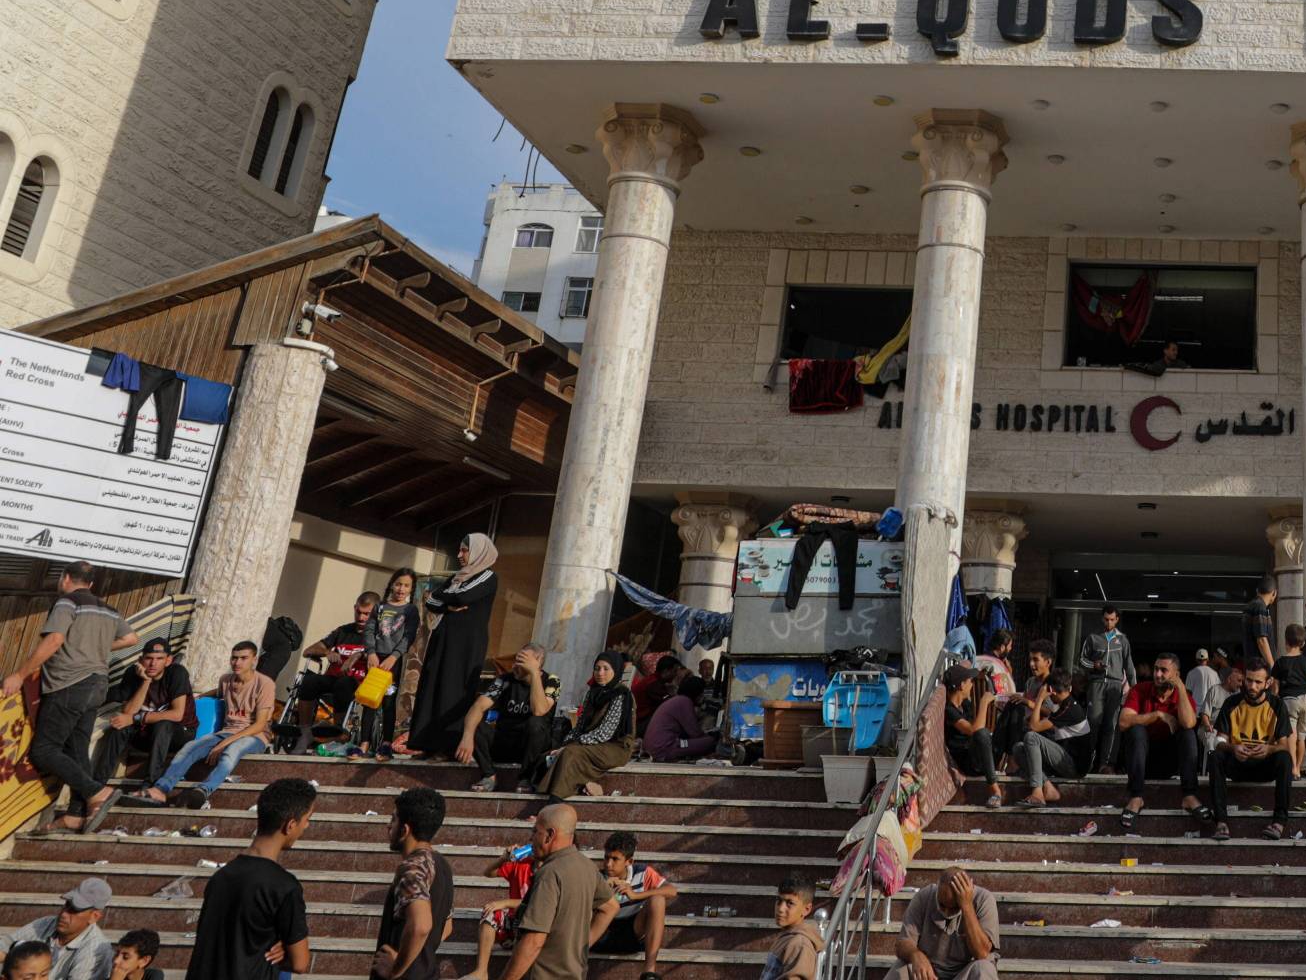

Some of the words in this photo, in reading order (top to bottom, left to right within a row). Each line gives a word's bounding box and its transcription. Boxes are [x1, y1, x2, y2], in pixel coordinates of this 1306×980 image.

[5, 368, 25, 381] Red
[27, 372, 56, 387] Cross
[10, 356, 28, 369] The
[30, 361, 86, 382] Netherlands
[995, 402, 1117, 434] HOSPITAL
[1194, 401, 1295, 444] القدس
[1, 500, 33, 511] MONTHS
